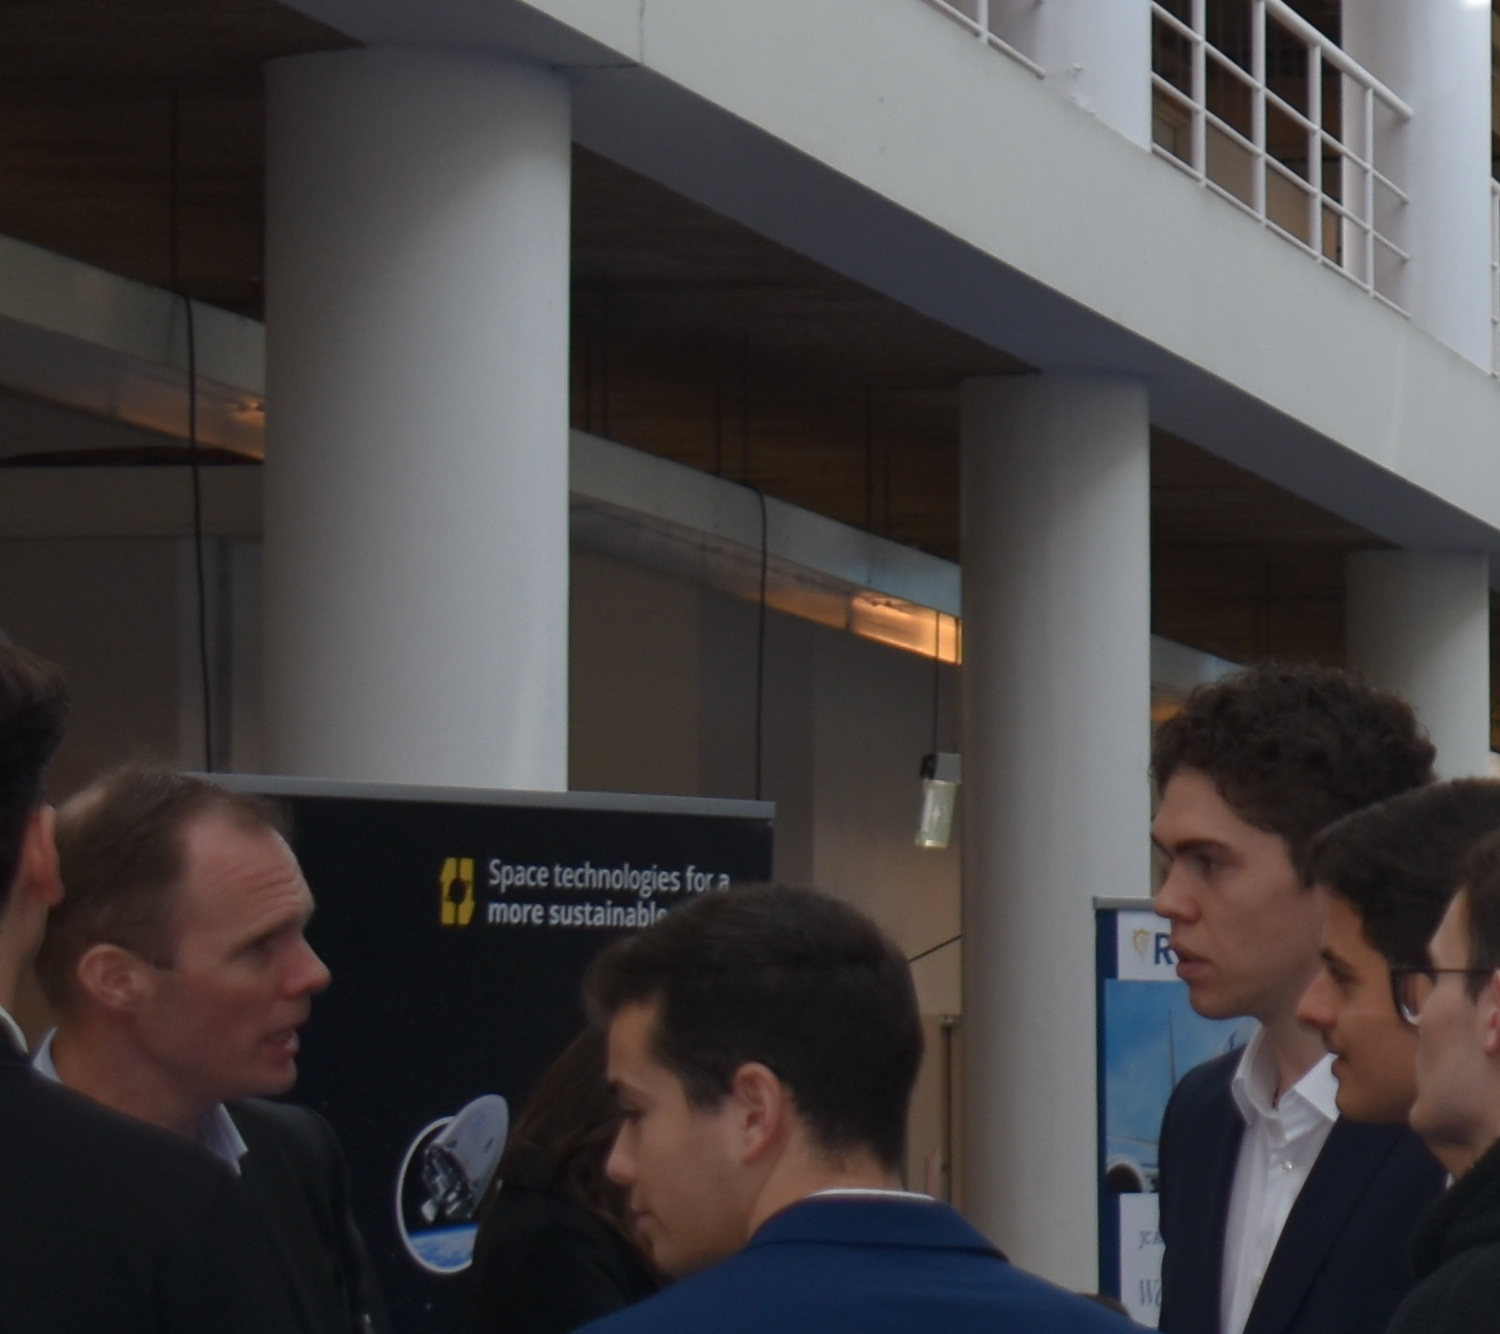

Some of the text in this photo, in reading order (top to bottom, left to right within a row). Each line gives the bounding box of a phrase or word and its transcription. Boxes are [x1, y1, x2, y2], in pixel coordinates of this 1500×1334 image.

[488, 858, 731, 899] Space technologies for a
[487, 901, 546, 925] more
